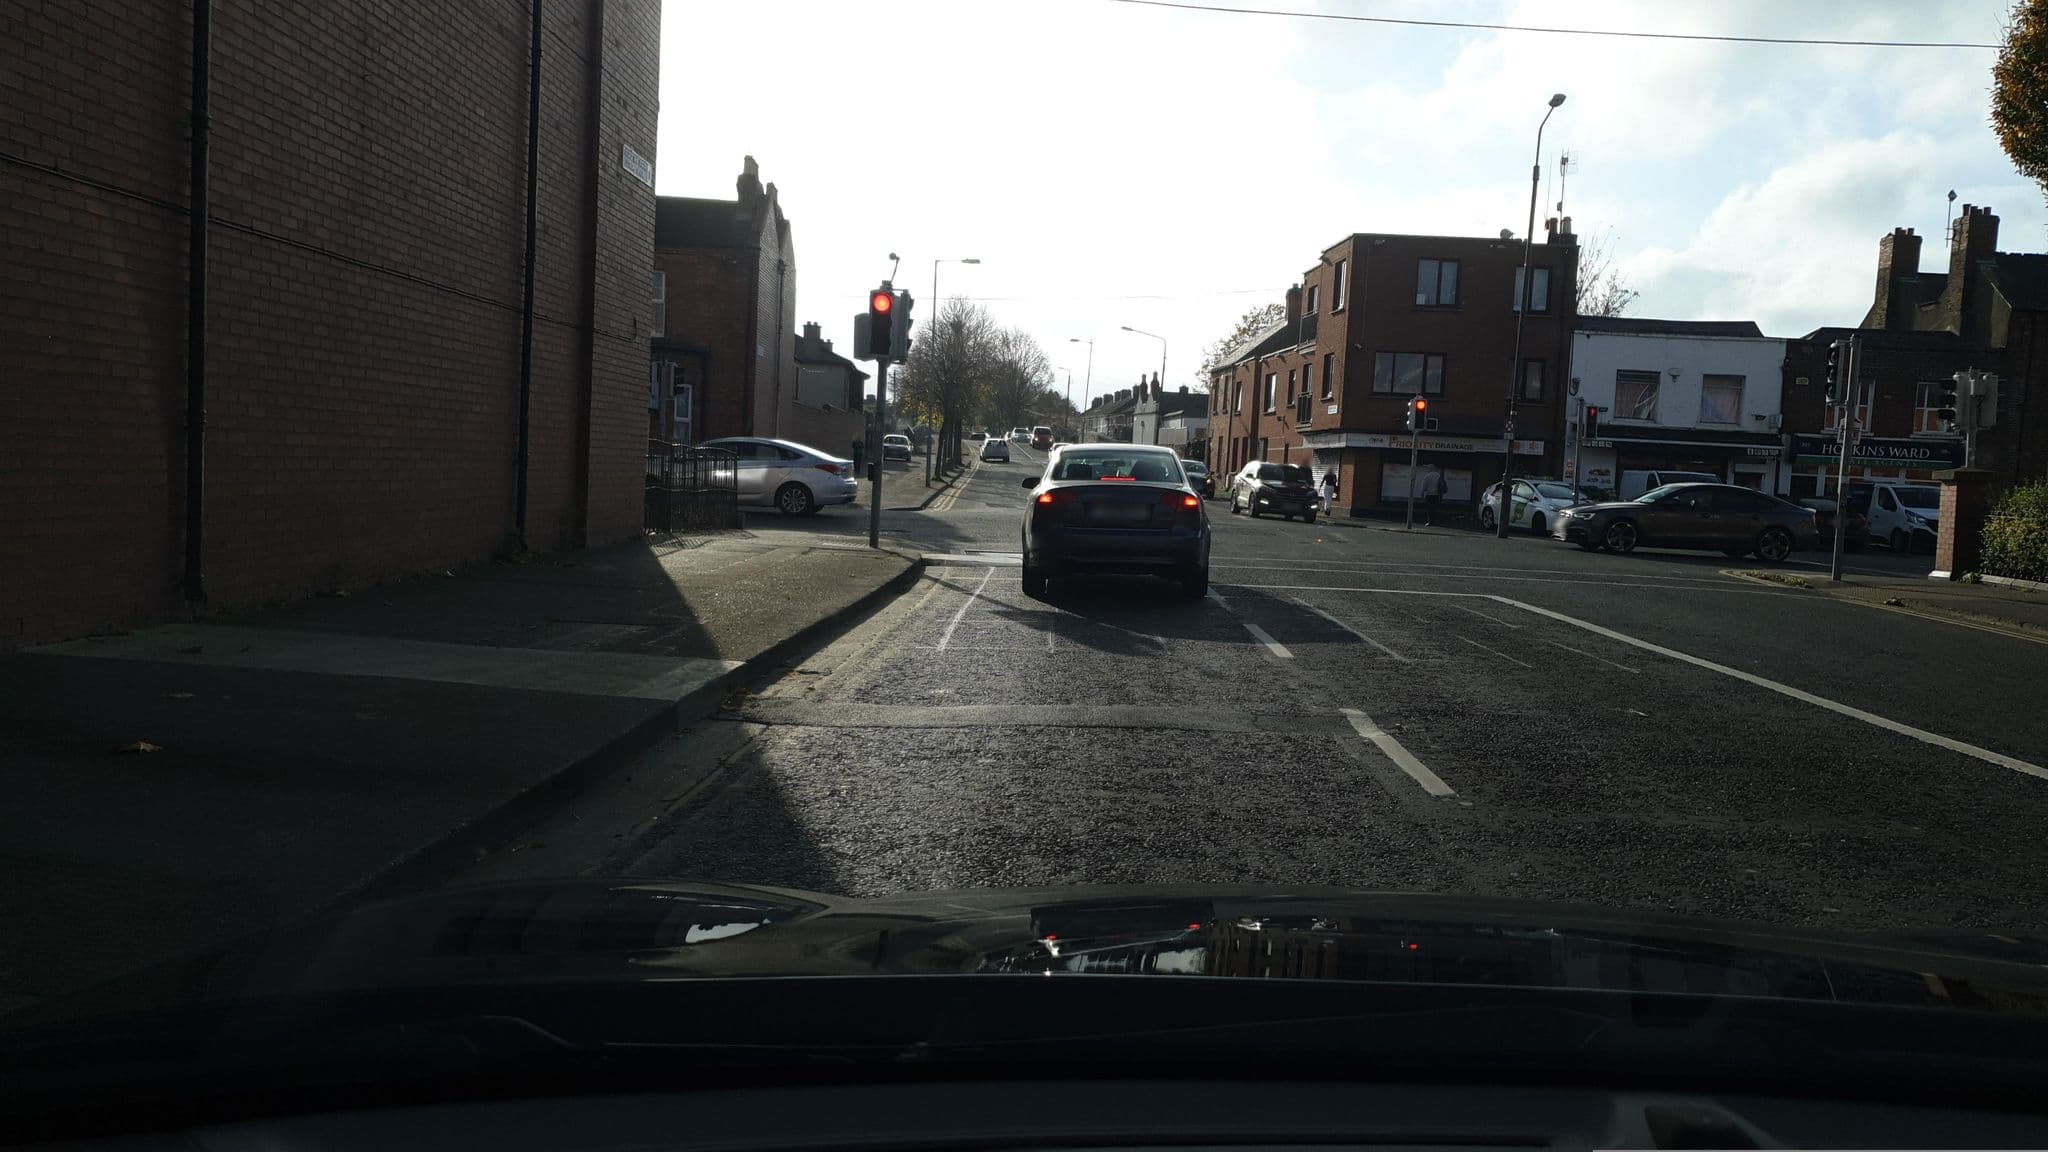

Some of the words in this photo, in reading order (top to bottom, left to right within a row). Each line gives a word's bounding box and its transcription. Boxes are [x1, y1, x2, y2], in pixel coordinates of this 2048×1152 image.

[1389, 436, 1434, 449] PRIOITY
[1435, 442, 1473, 450] DRAINAGE
[1822, 443, 1885, 457] HOKINS
[1889, 447, 1930, 459] WARD
